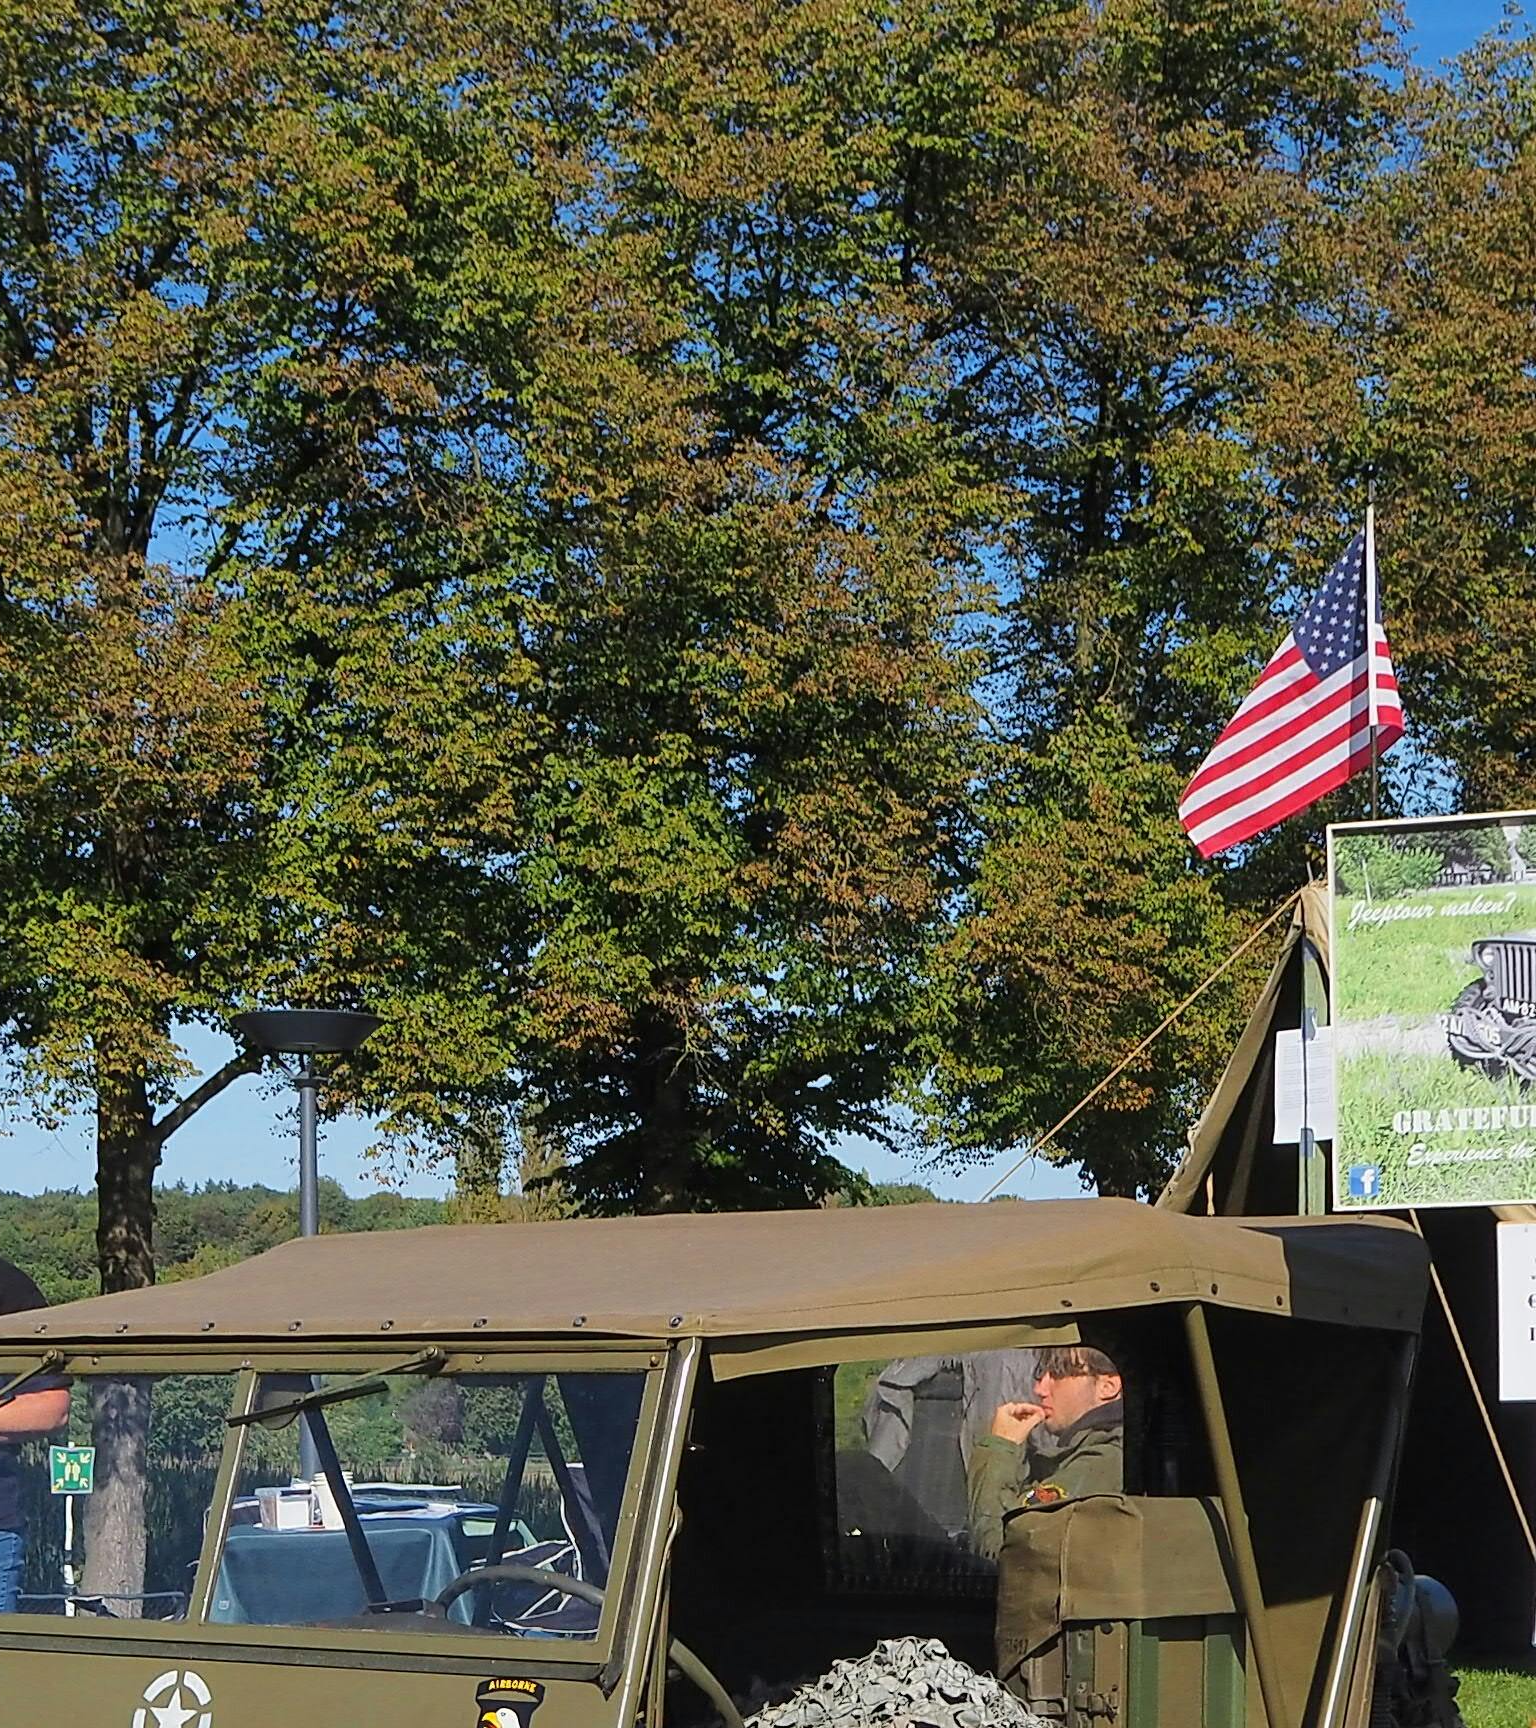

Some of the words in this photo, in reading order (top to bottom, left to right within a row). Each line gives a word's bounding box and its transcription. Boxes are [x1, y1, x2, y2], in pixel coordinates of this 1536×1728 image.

[1346, 899, 1434, 932] Jeeptour
[1440, 891, 1517, 916] maken?
[1407, 1142, 1505, 1168] Experience
[488, 1679, 538, 1693] AIRBORNE
